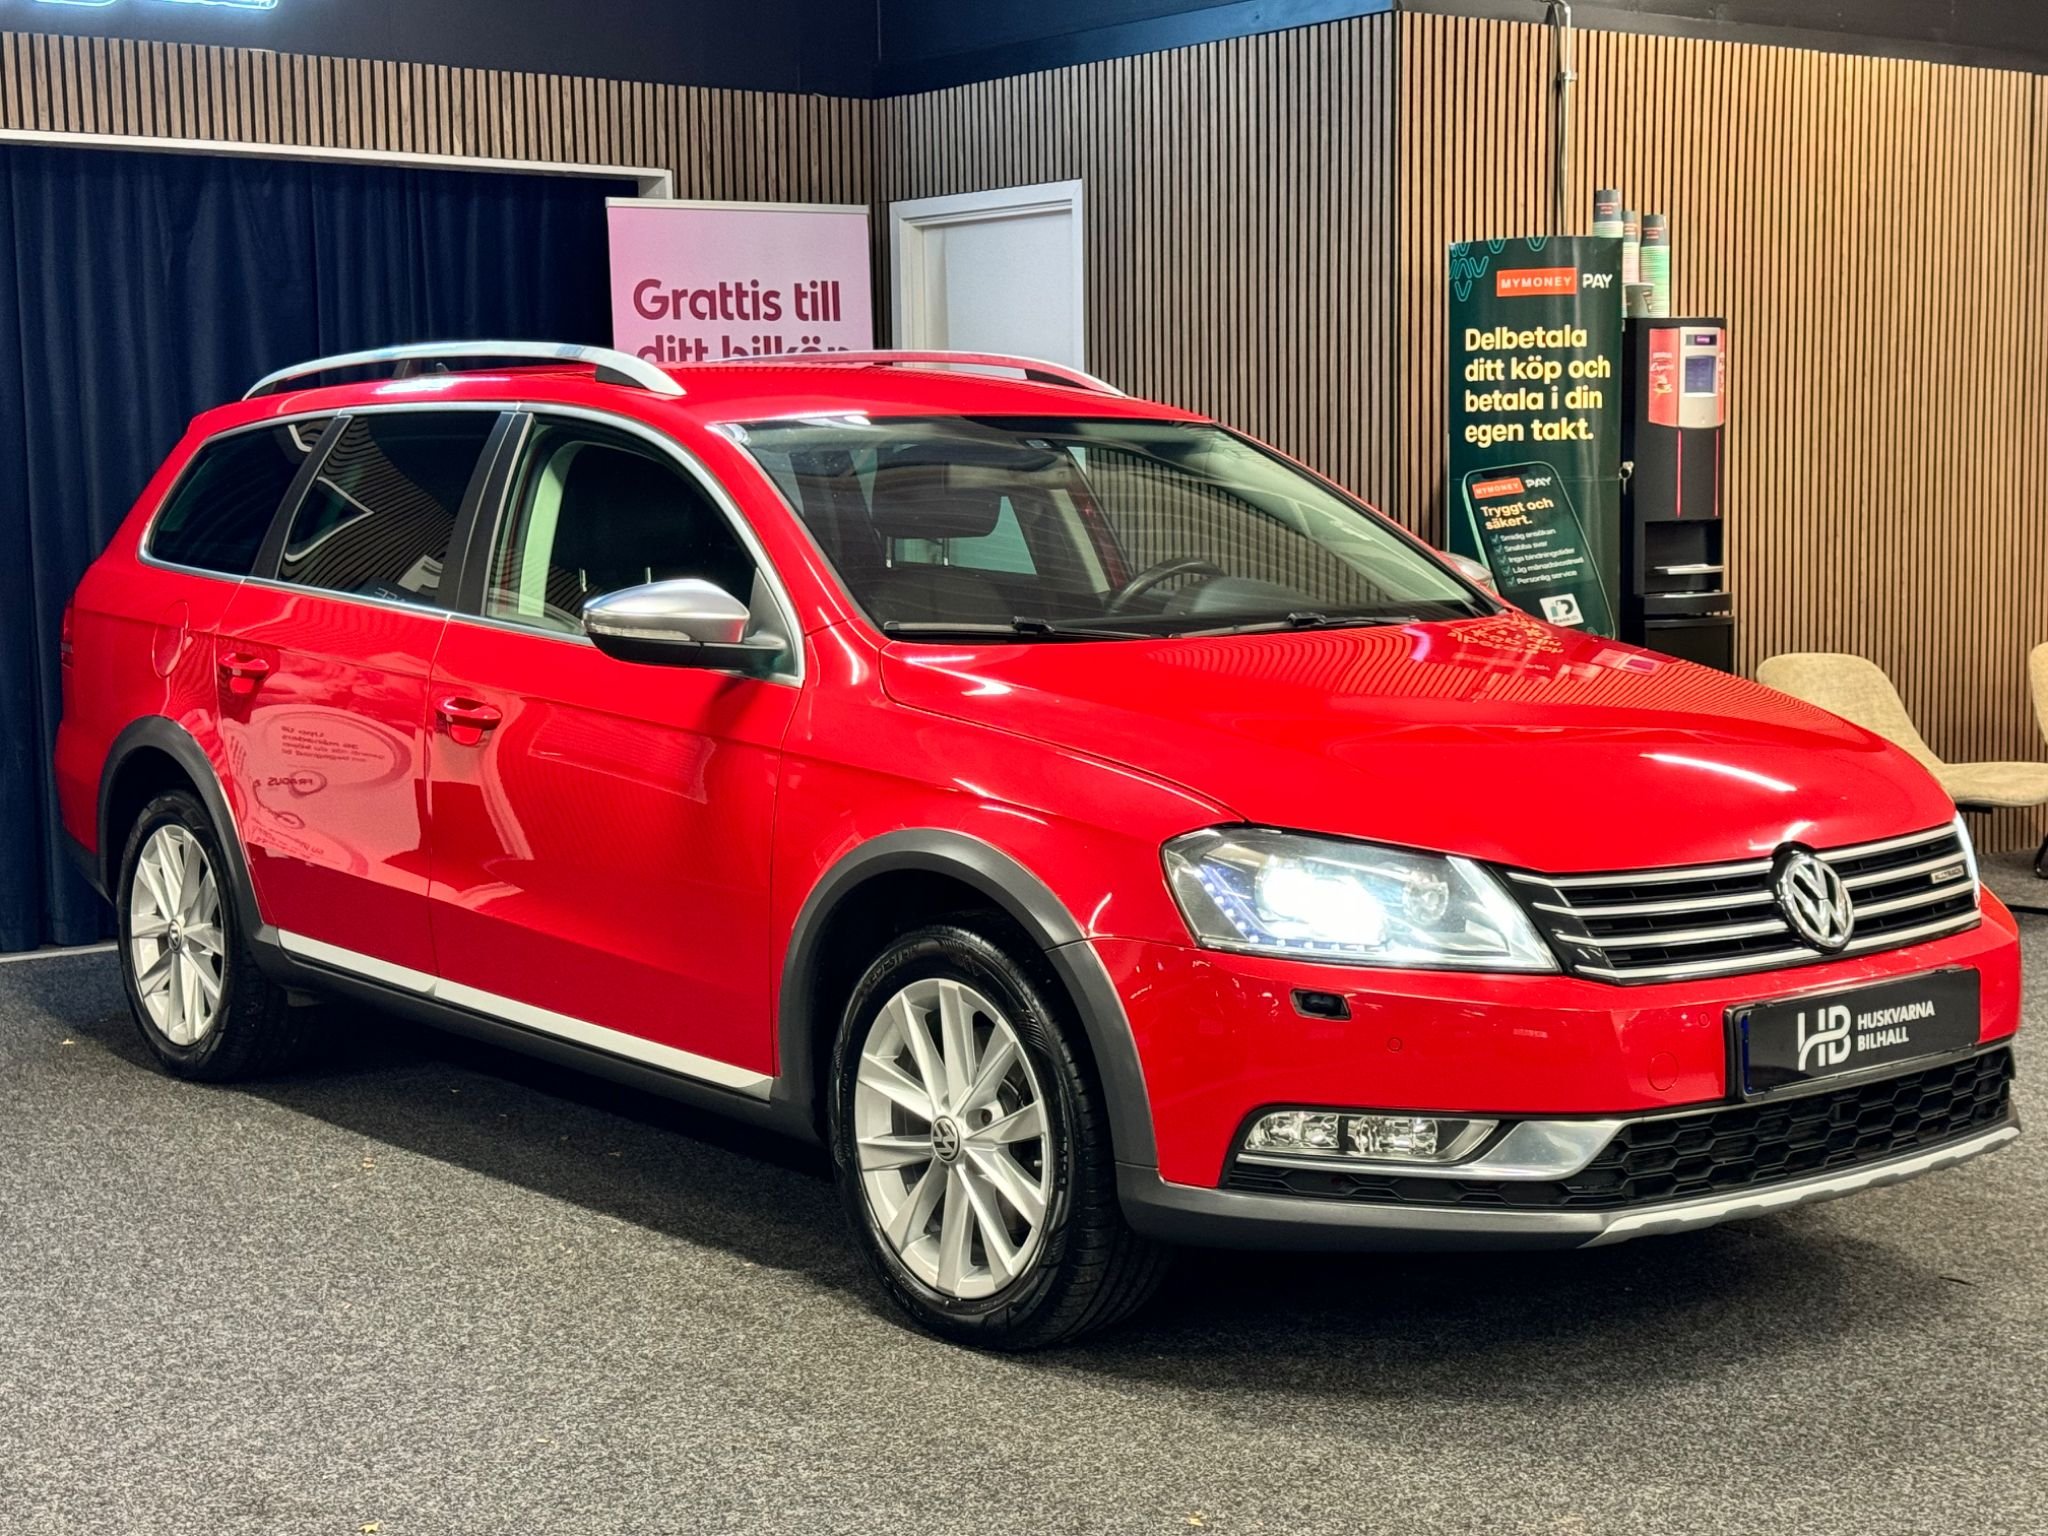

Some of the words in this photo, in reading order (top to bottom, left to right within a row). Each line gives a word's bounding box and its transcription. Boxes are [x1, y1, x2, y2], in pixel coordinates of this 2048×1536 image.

[1500, 276, 1573, 289] MYMONEY
[1582, 273, 1613, 289] PAY
[633, 279, 783, 322] Grattis
[794, 280, 841, 322] till
[1465, 324, 1588, 351] Delbetala
[1465, 357, 1505, 382] ditt
[1511, 355, 1562, 384] köp
[1568, 355, 1611, 379] och
[1465, 387, 1544, 412] betala
[1551, 385, 1558, 410] i
[1564, 385, 1603, 409] din
[1465, 423, 1525, 448] egen
[1531, 417, 1594, 441] takt.
[1525, 476, 1552, 488] PAY
[1480, 500, 1526, 518] Tryggt
[1526, 498, 1555, 511] och
[1485, 515, 1533, 530] säkert.
[1516, 574, 1551, 585] Personlig
[1857, 1000, 1935, 1030] HUSKVARNA
[1857, 1029, 1909, 1051] BILHALL
